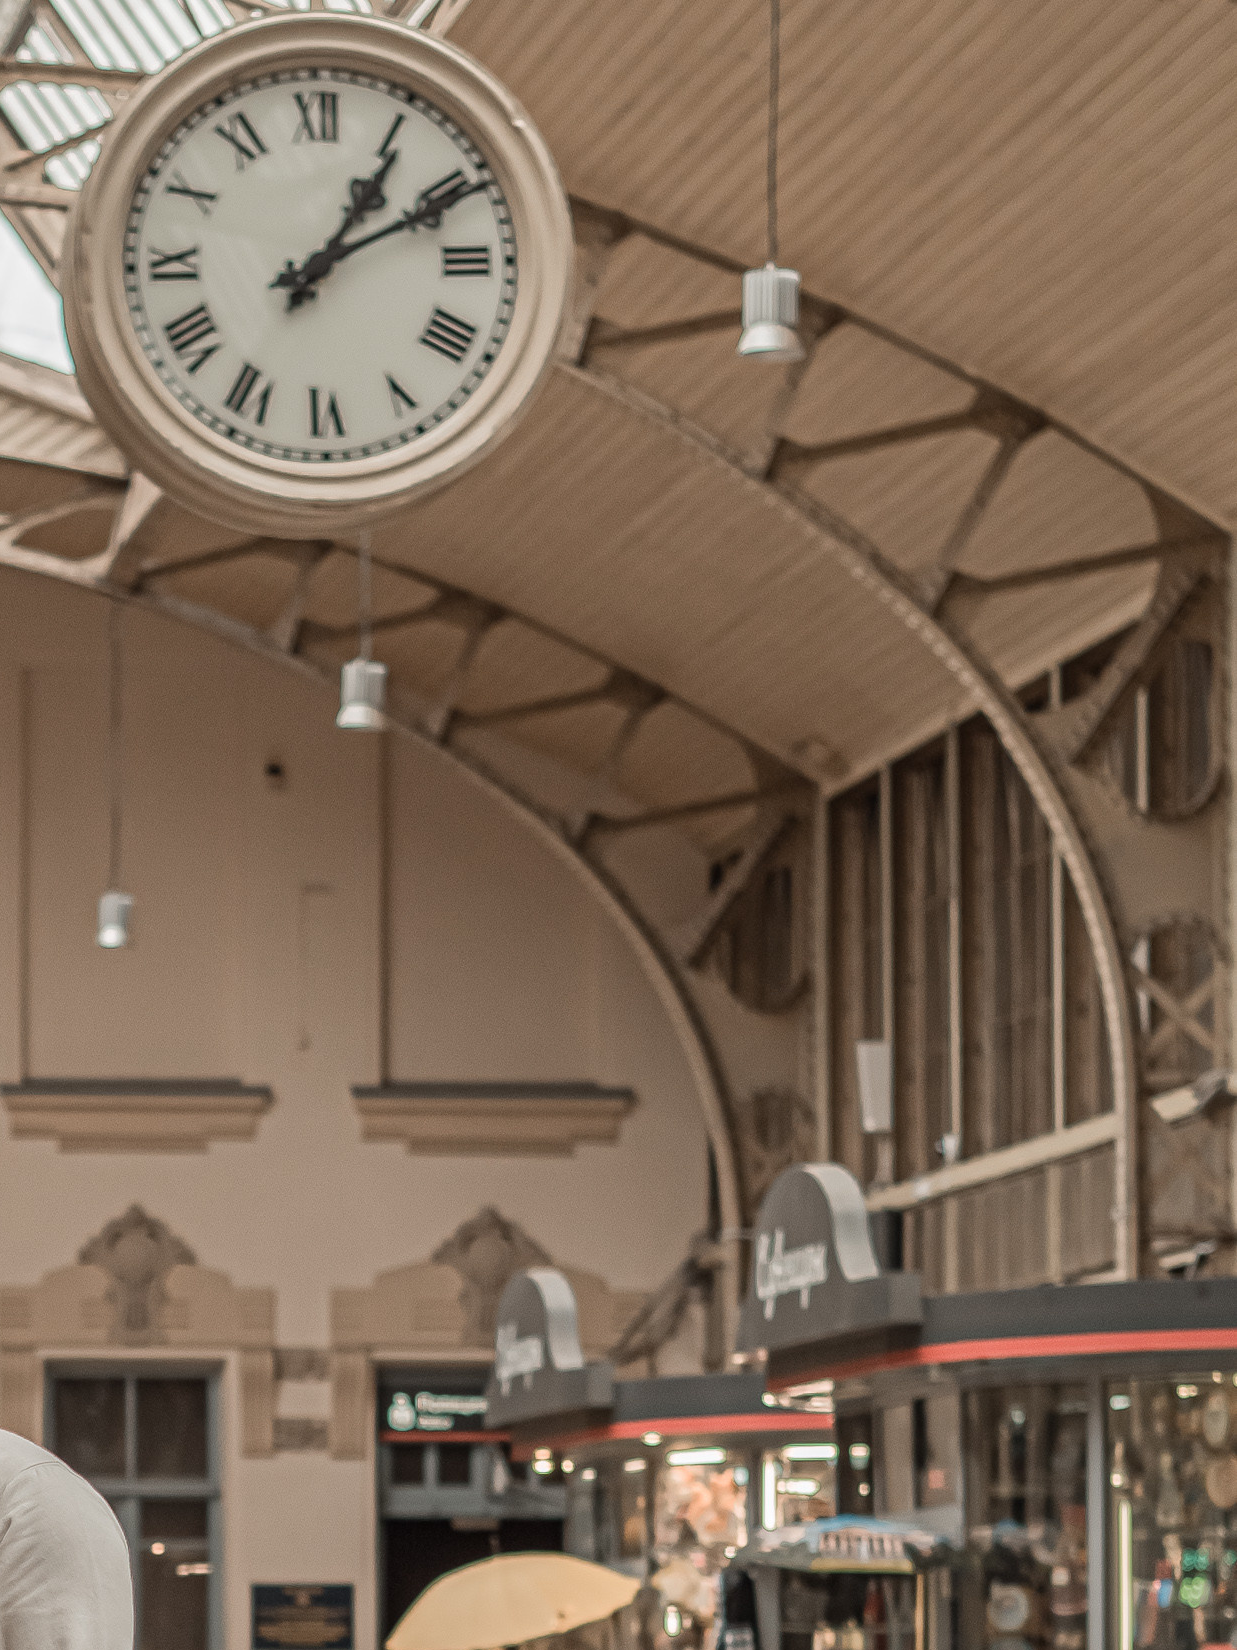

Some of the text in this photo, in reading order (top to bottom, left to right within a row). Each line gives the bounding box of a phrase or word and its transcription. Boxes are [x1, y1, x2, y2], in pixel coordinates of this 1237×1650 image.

[215, 111, 268, 171] XI
[292, 92, 339, 142] XII
[378, 113, 405, 157] I
[166, 169, 217, 215] X
[149, 245, 199, 281] IX
[442, 246, 490, 276] III
[165, 303, 221, 374] VIII
[418, 307, 478, 362] IIII
[224, 363, 275, 426] VII
[309, 386, 345, 437] VI
[384, 372, 418, 417] V
